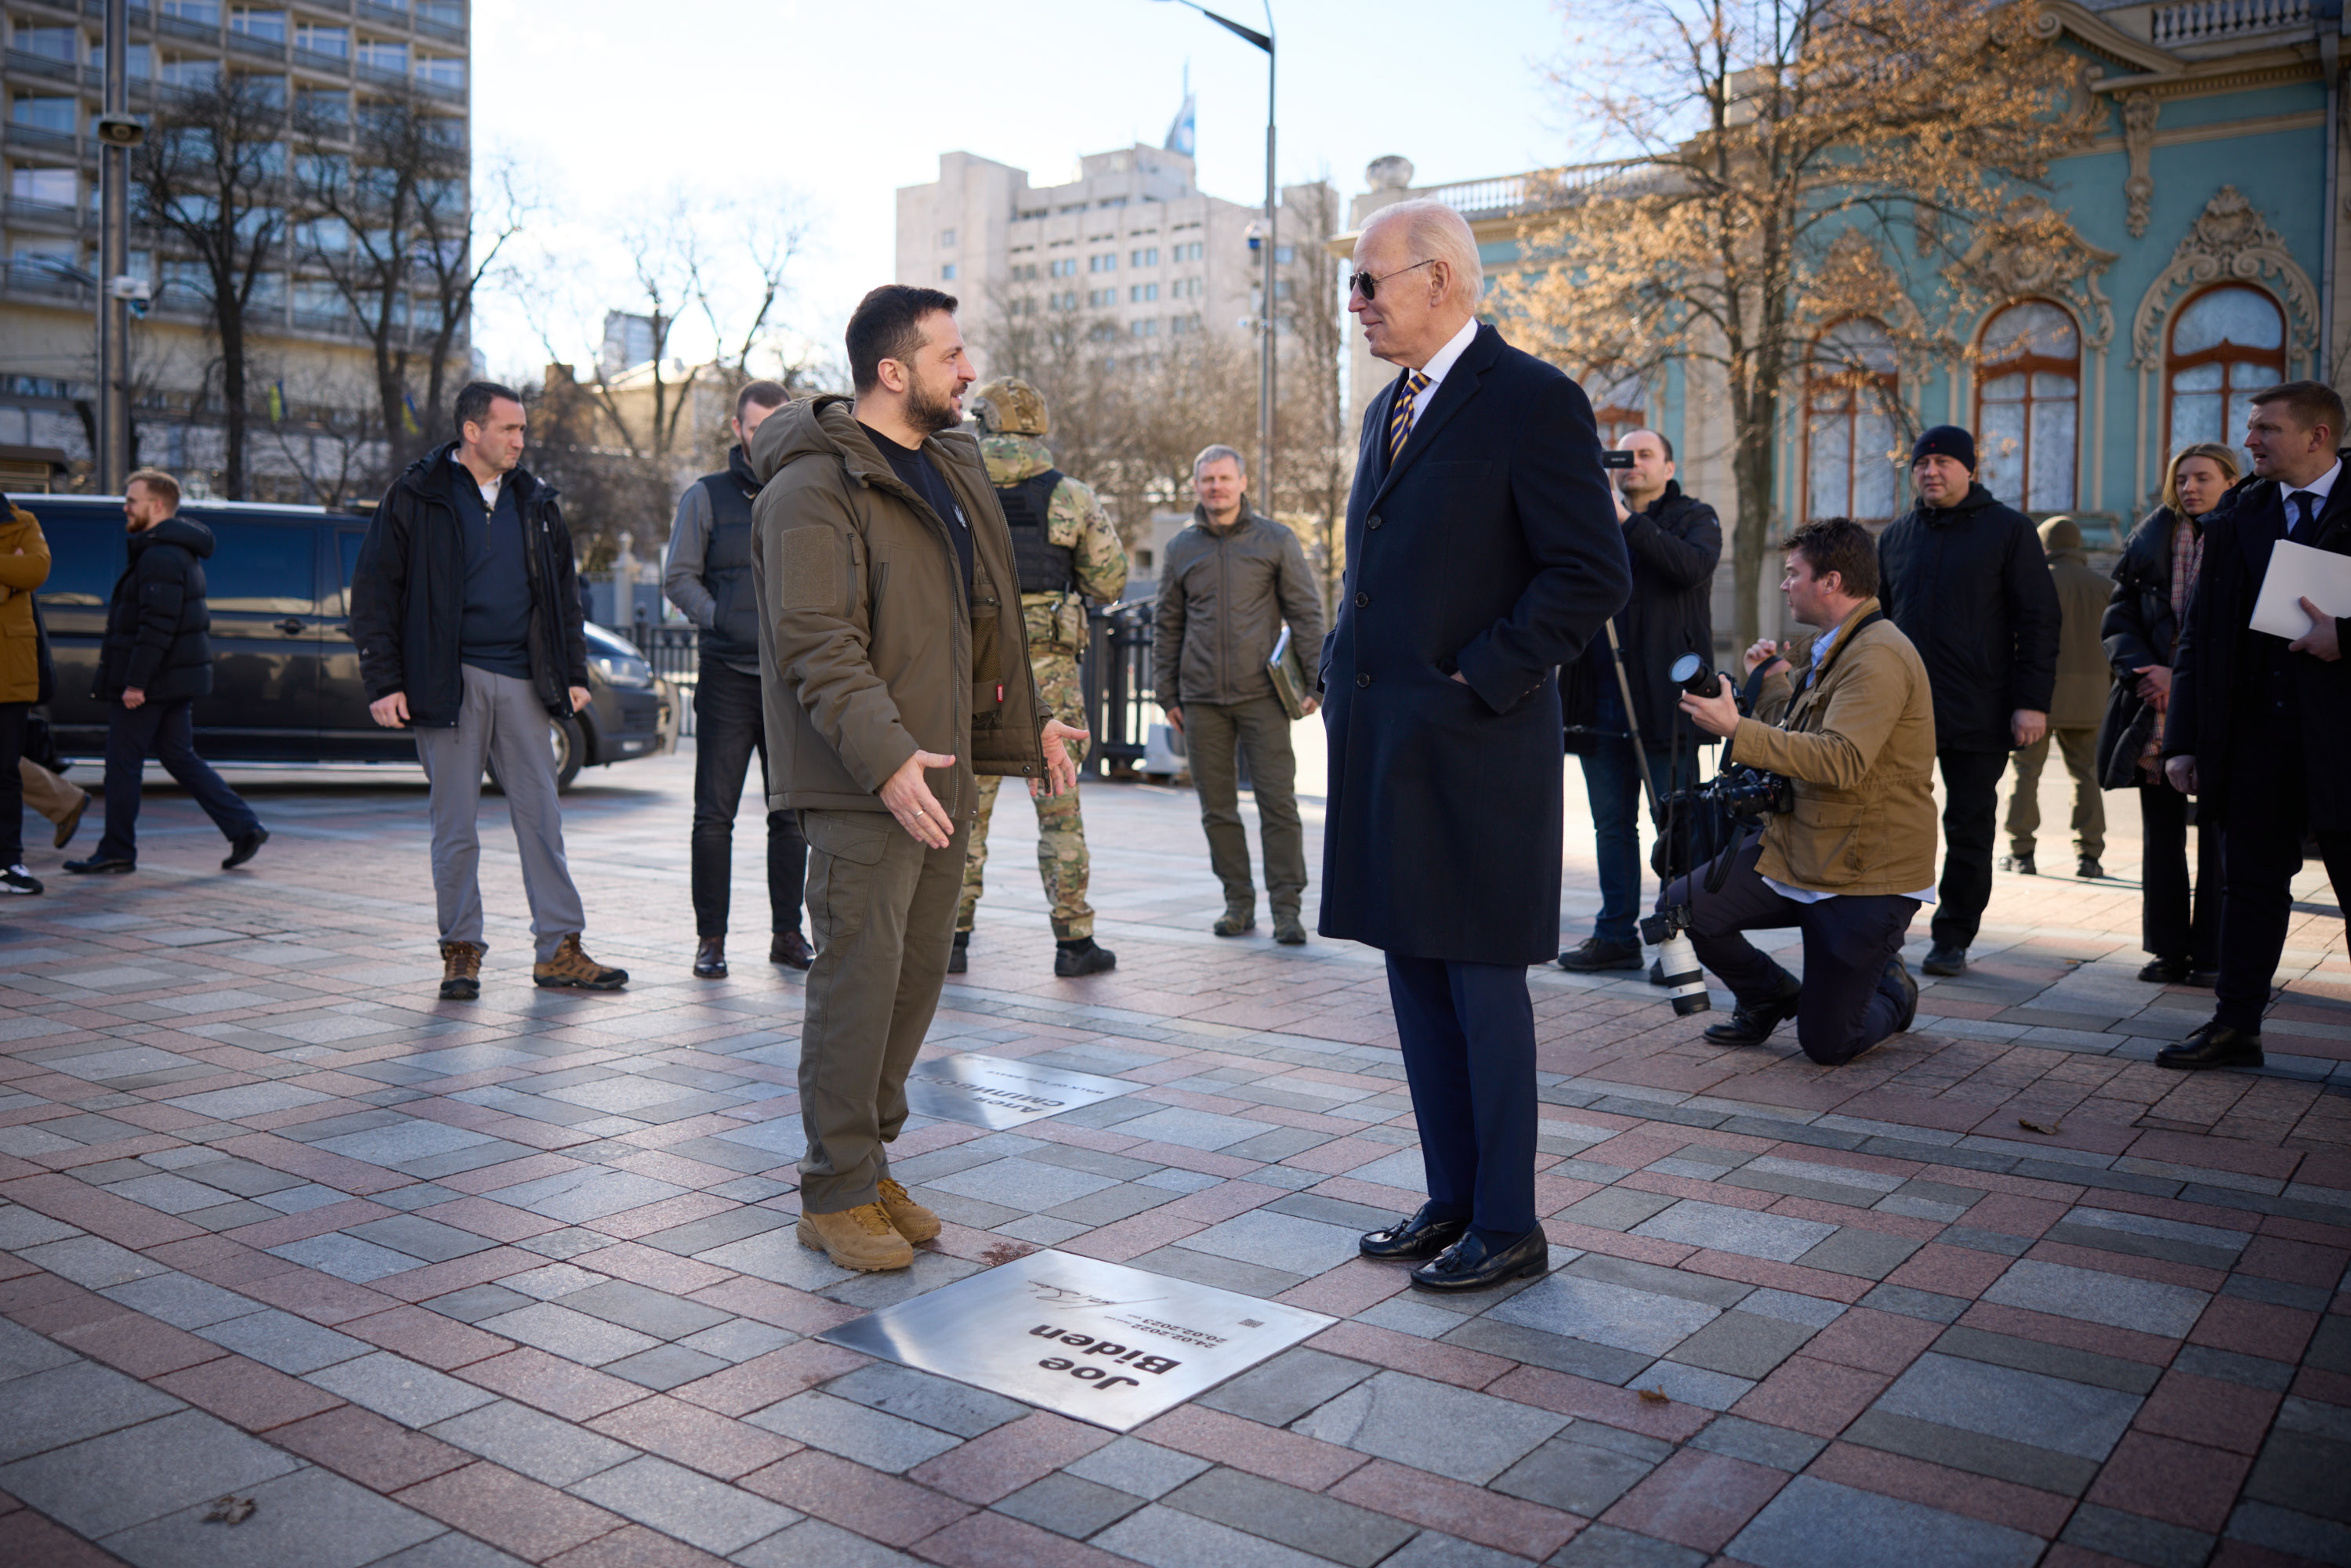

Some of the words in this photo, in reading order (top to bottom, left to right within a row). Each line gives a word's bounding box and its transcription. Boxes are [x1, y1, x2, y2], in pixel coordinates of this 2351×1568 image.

[1131, 1324, 1218, 1349] 24.02.2022
[1142, 1319, 1229, 1343] 20.02.2023
[1028, 1324, 1182, 1375] Biden
[1038, 1357, 1140, 1391] Joe
